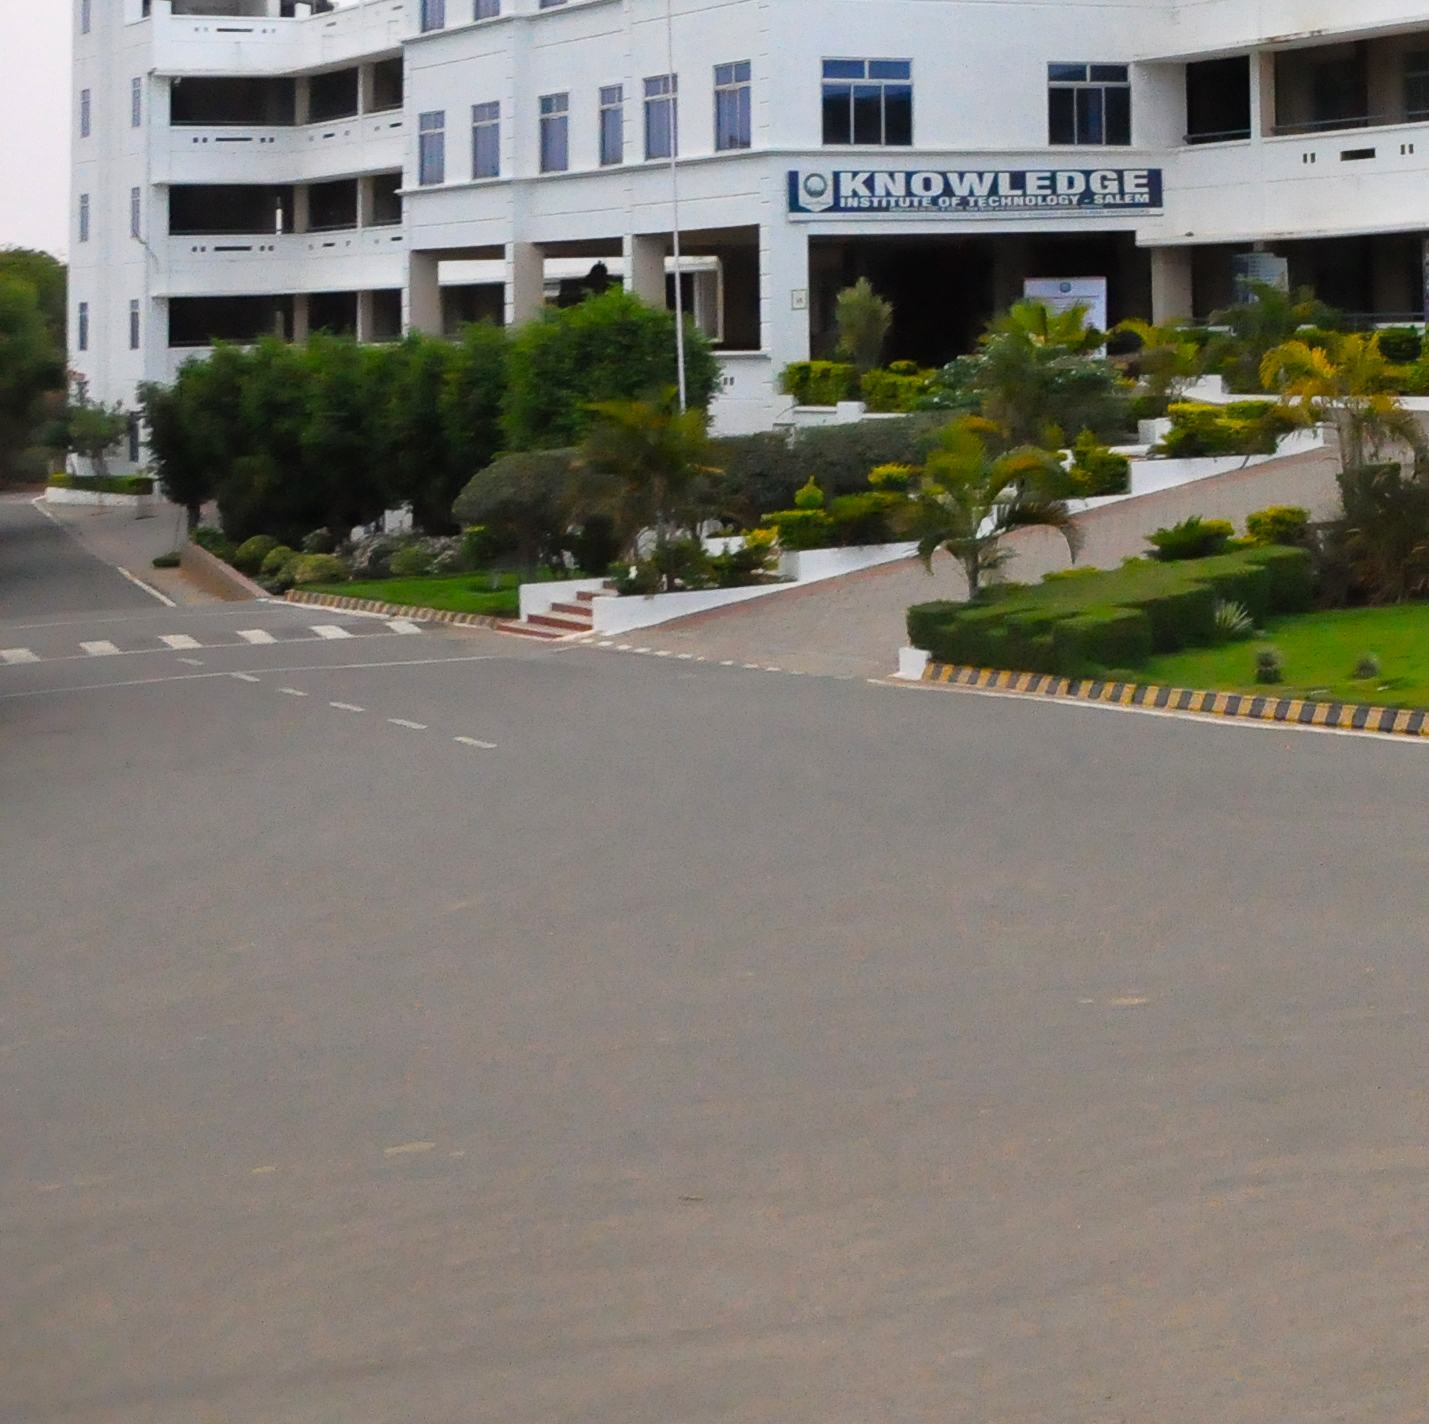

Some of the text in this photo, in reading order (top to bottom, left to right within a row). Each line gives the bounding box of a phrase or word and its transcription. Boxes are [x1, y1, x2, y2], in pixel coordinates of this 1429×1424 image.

[839, 170, 1149, 197] KNOWLEDGE
[840, 195, 932, 208] INSTITUTE
[938, 196, 961, 208] OF
[967, 194, 1080, 207] TECHNOLOGY
[1094, 194, 1149, 205] SALEM
